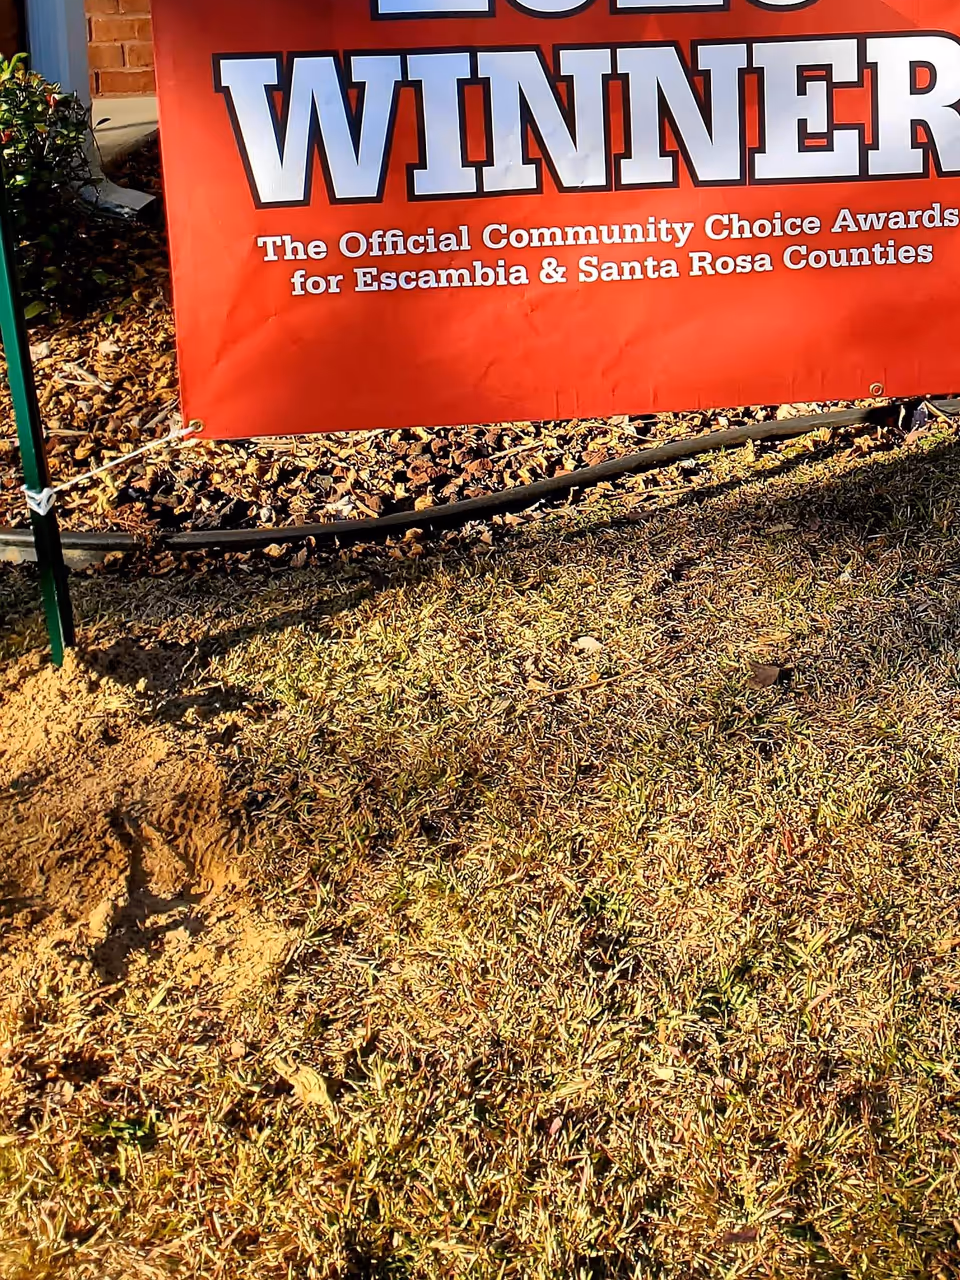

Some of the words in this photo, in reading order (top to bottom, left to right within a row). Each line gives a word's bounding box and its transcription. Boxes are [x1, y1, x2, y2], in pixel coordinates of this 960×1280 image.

[257, 233, 329, 263] The
[337, 226, 471, 259] Official
[481, 218, 693, 256] Community
[703, 210, 821, 241] Choice
[831, 203, 960, 234] Awards
[290, 268, 342, 296] for
[353, 260, 529, 293] Escambia
[537, 259, 568, 285] &
[577, 253, 681, 283] Santa
[688, 249, 774, 278] Rosa
[781, 240, 934, 272] Counties
